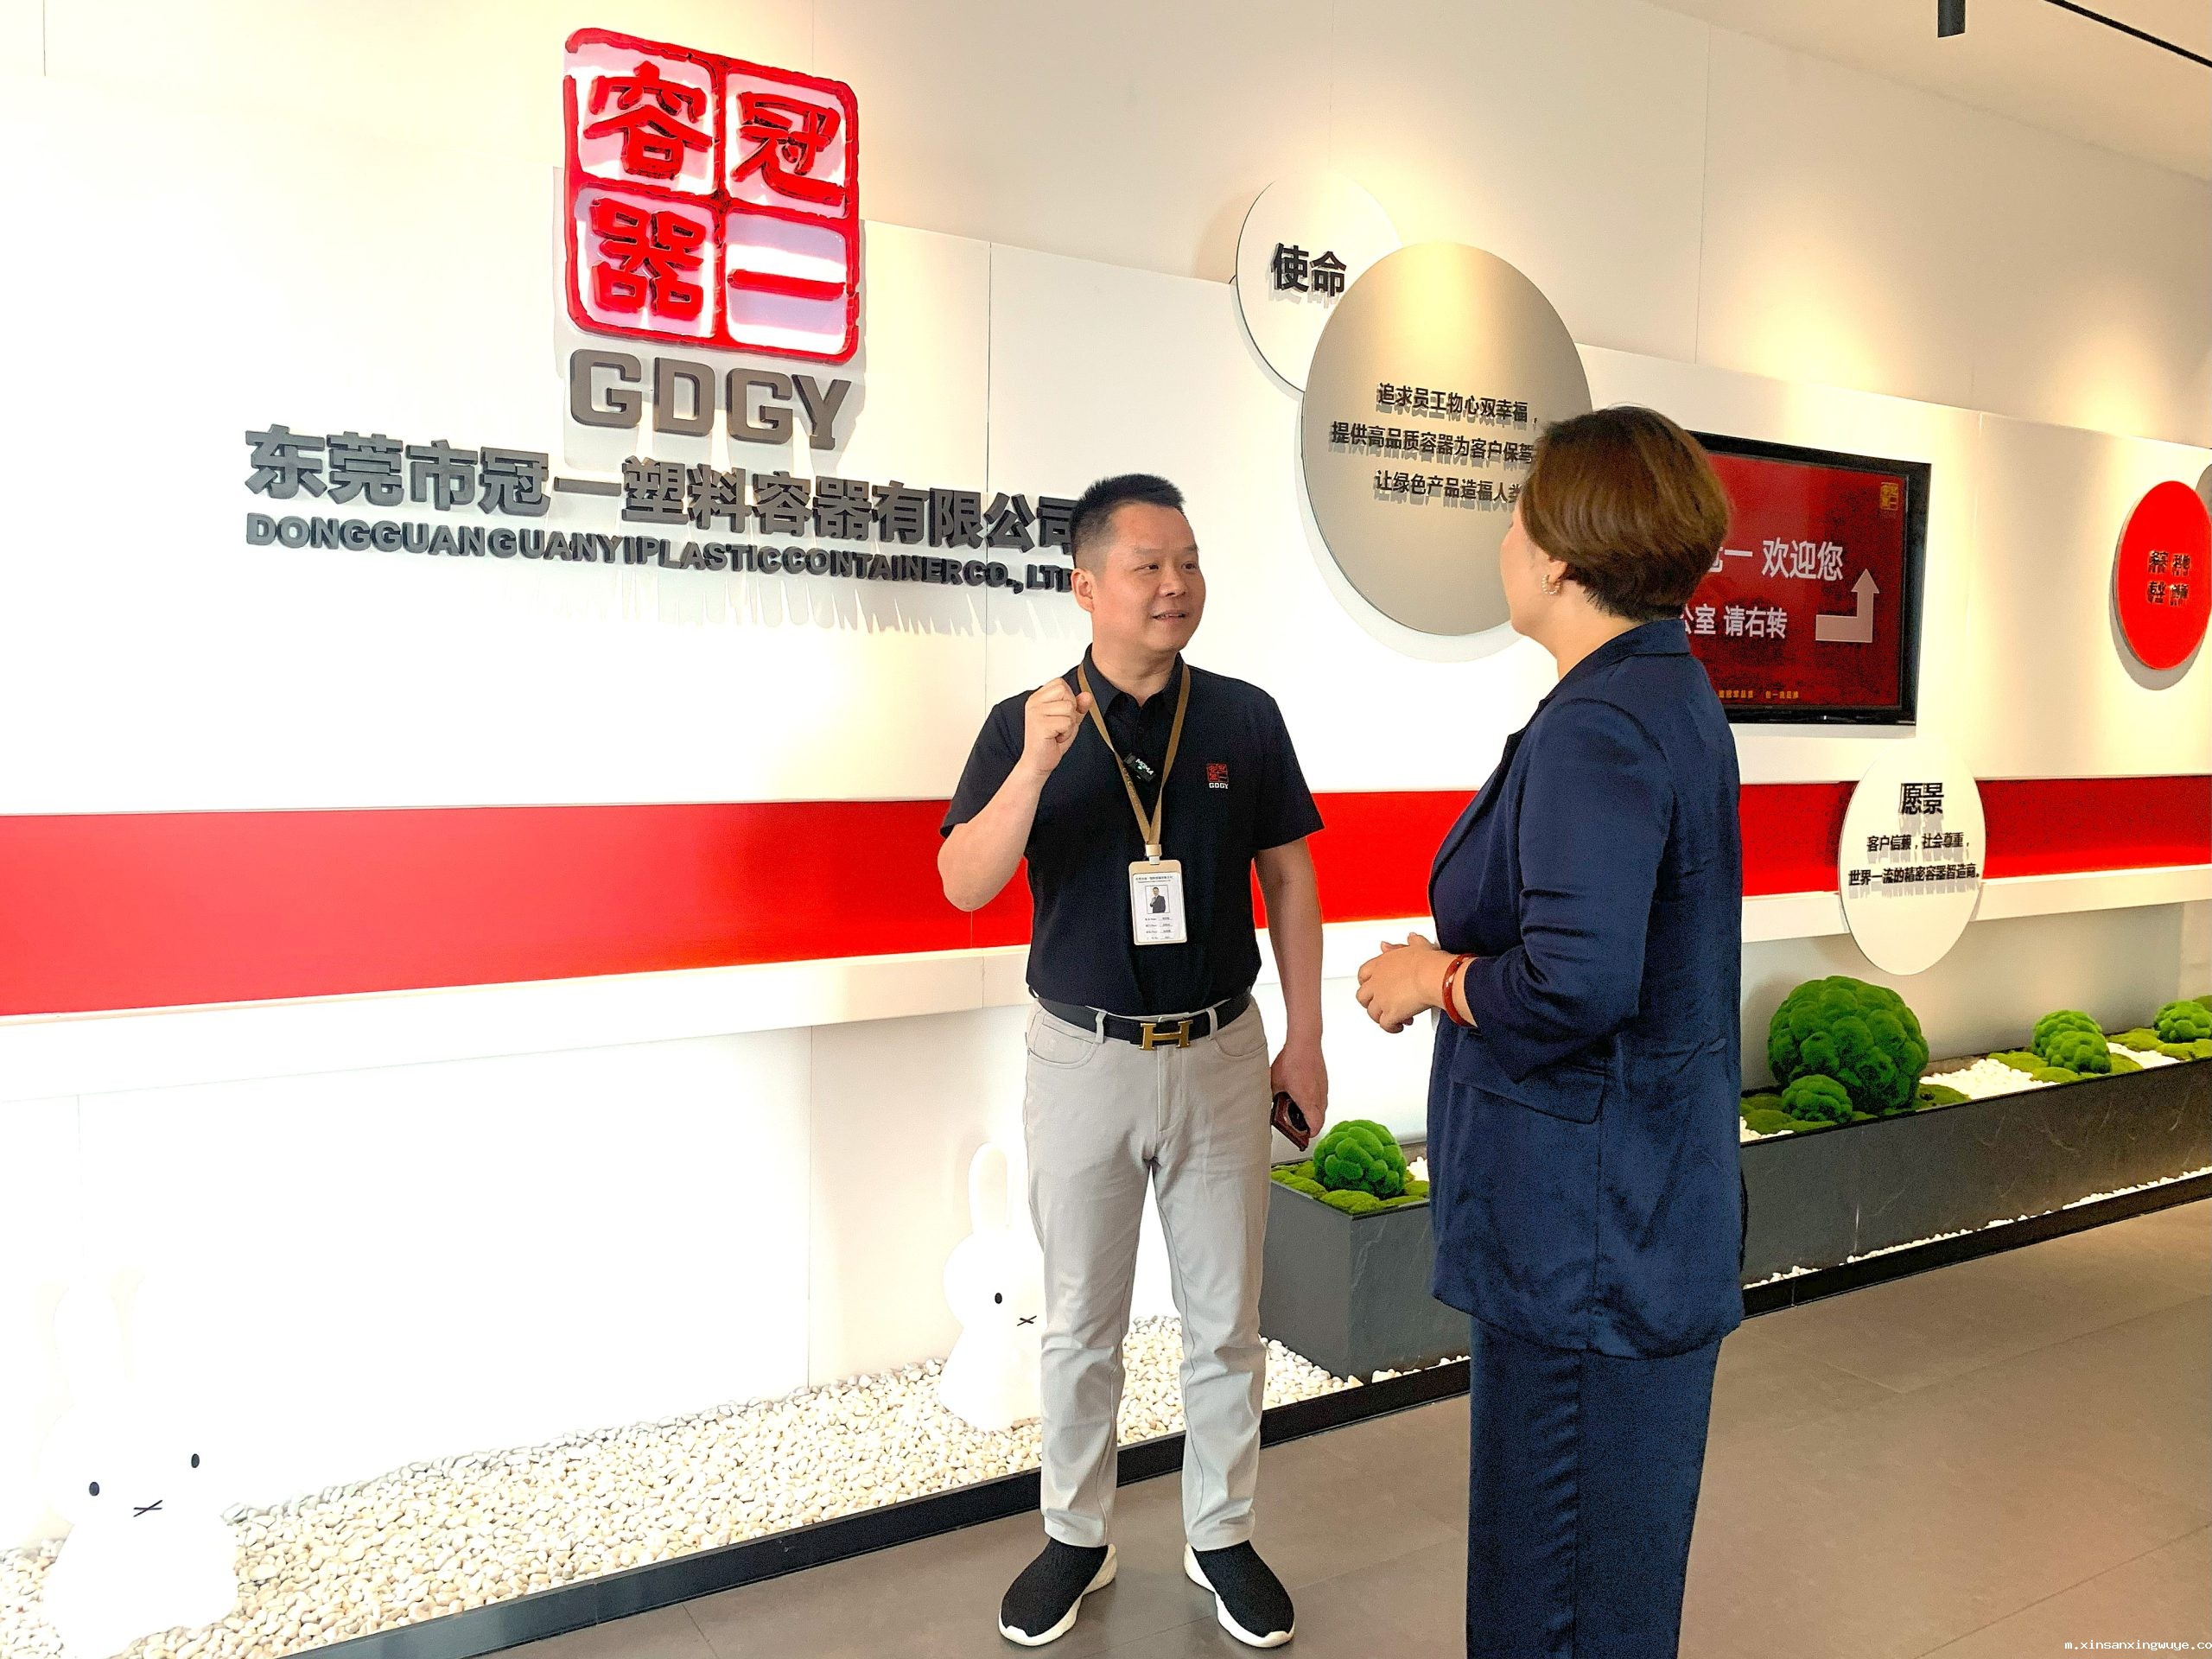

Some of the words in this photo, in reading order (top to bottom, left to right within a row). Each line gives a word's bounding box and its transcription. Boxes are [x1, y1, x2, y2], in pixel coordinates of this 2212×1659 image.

[1270, 243, 1347, 296] 使命
[570, 348, 851, 449] GDGY
[245, 423, 1077, 556] 东莞市冠一塑料容器有限公司
[1762, 537, 1843, 581] 欢迎您
[1723, 605, 1787, 639] 请右转
[1901, 783, 1944, 815] 愿景
